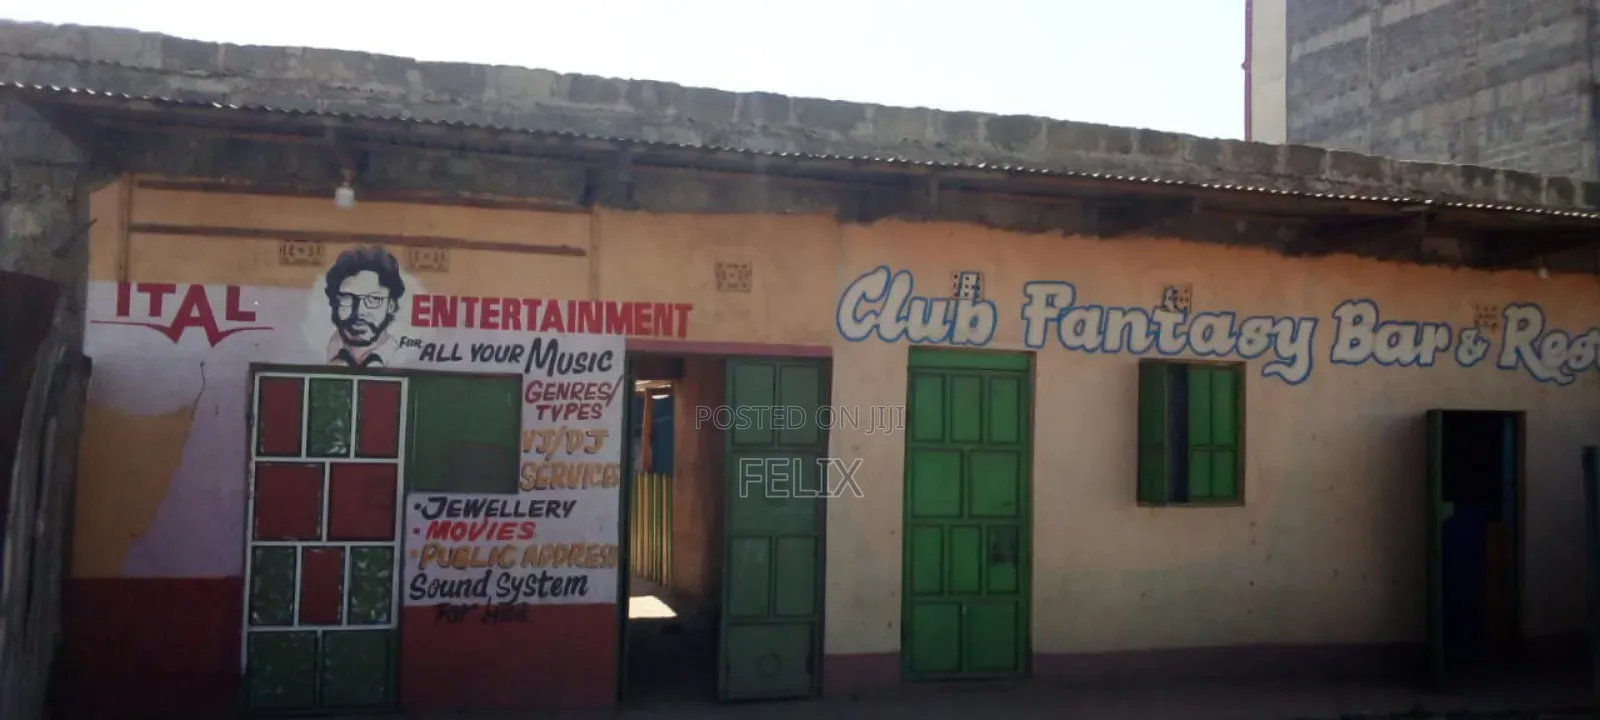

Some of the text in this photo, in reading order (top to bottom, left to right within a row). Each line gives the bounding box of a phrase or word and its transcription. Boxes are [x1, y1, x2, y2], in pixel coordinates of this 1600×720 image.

[114, 281, 693, 348] ITAL ENTERTAINMENT
[836, 265, 1600, 386] Club Fantasy Bar & Res
[419, 342, 462, 362] ALL
[469, 343, 525, 364] YOUR
[525, 374, 624, 408] GENRES/
[536, 403, 603, 422] TYPES
[421, 496, 577, 519] JEWELLERY
[425, 520, 536, 541] MOVIES
[418, 544, 517, 570] PUBLIC
[409, 569, 492, 601] Sound
